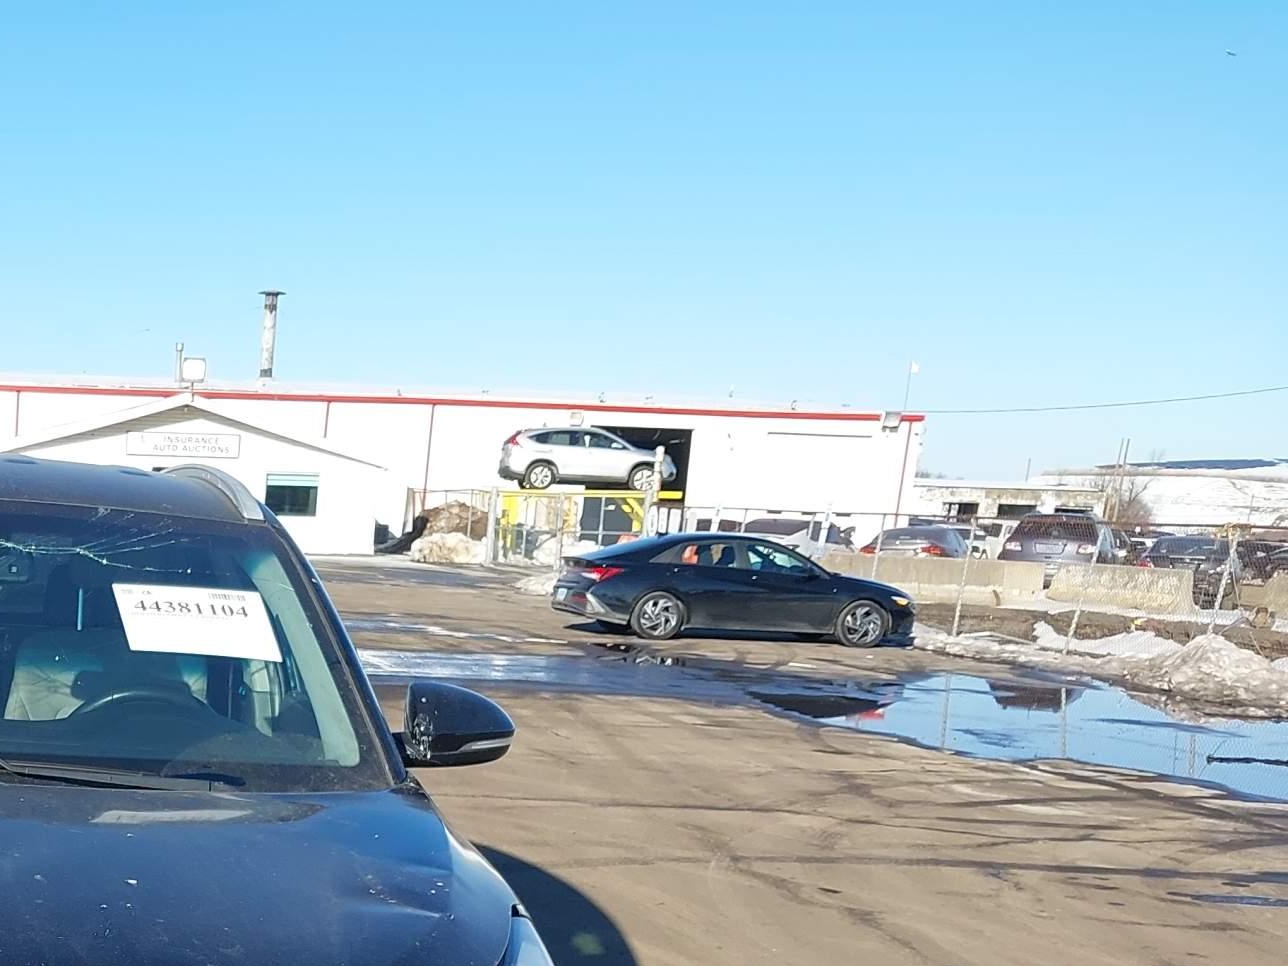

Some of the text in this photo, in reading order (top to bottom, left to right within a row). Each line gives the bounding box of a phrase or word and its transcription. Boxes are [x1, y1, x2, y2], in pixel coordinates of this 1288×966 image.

[163, 435, 220, 445] INSURANCE
[152, 443, 231, 454] AUTO AUCTIONS
[133, 599, 249, 618] 44381104
